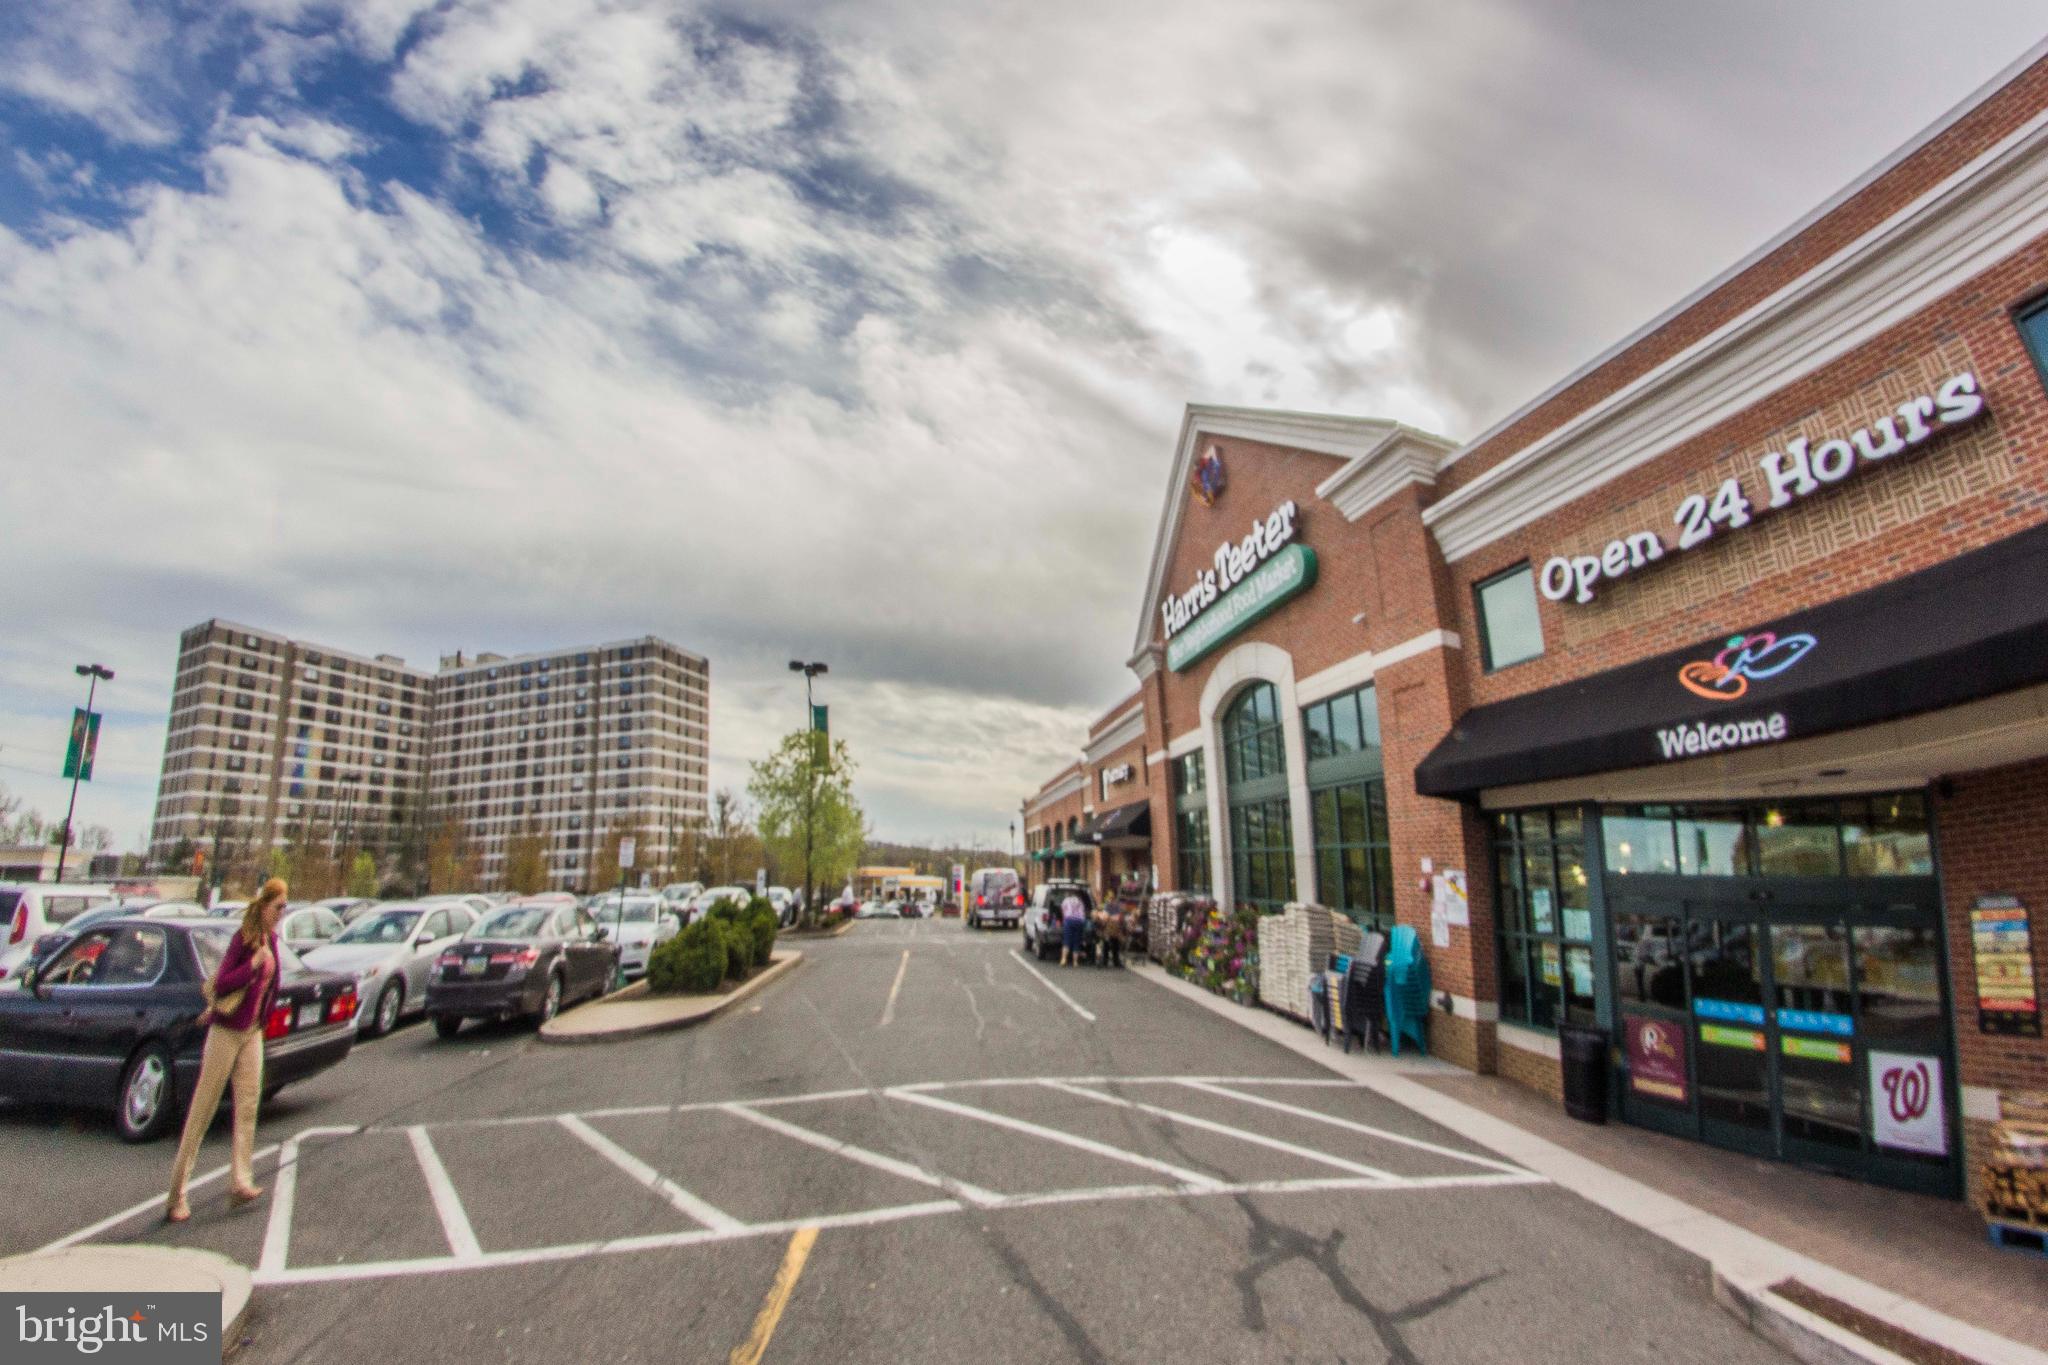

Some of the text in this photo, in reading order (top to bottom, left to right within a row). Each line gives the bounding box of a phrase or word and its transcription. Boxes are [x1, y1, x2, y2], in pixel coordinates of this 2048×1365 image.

[1540, 371, 1985, 604] Open 24 Hours
[1161, 500, 1296, 640] Harris Teeter
[1658, 711, 1787, 758] Welcome
[1881, 1061, 1930, 1123] W
